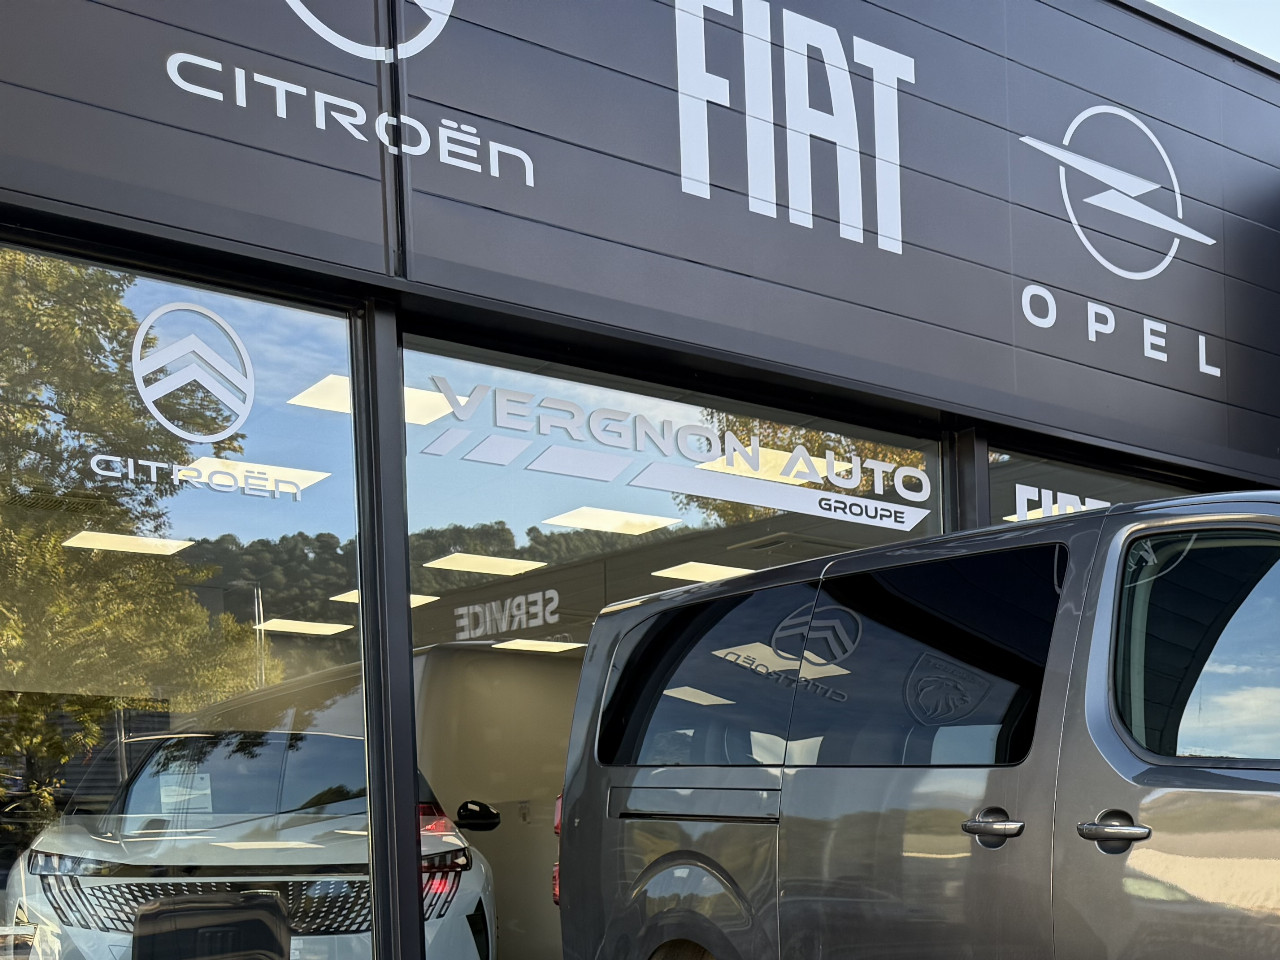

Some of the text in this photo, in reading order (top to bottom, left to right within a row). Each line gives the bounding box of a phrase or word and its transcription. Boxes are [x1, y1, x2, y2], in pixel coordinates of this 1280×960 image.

[167, 52, 534, 187] CITROËN
[674, 0, 915, 254] FIAT
[1021, 284, 1221, 377] OPEL
[91, 454, 301, 501] CITROËN
[430, 375, 931, 501] VERGNON AUTO
[818, 497, 906, 525] GROUPE
